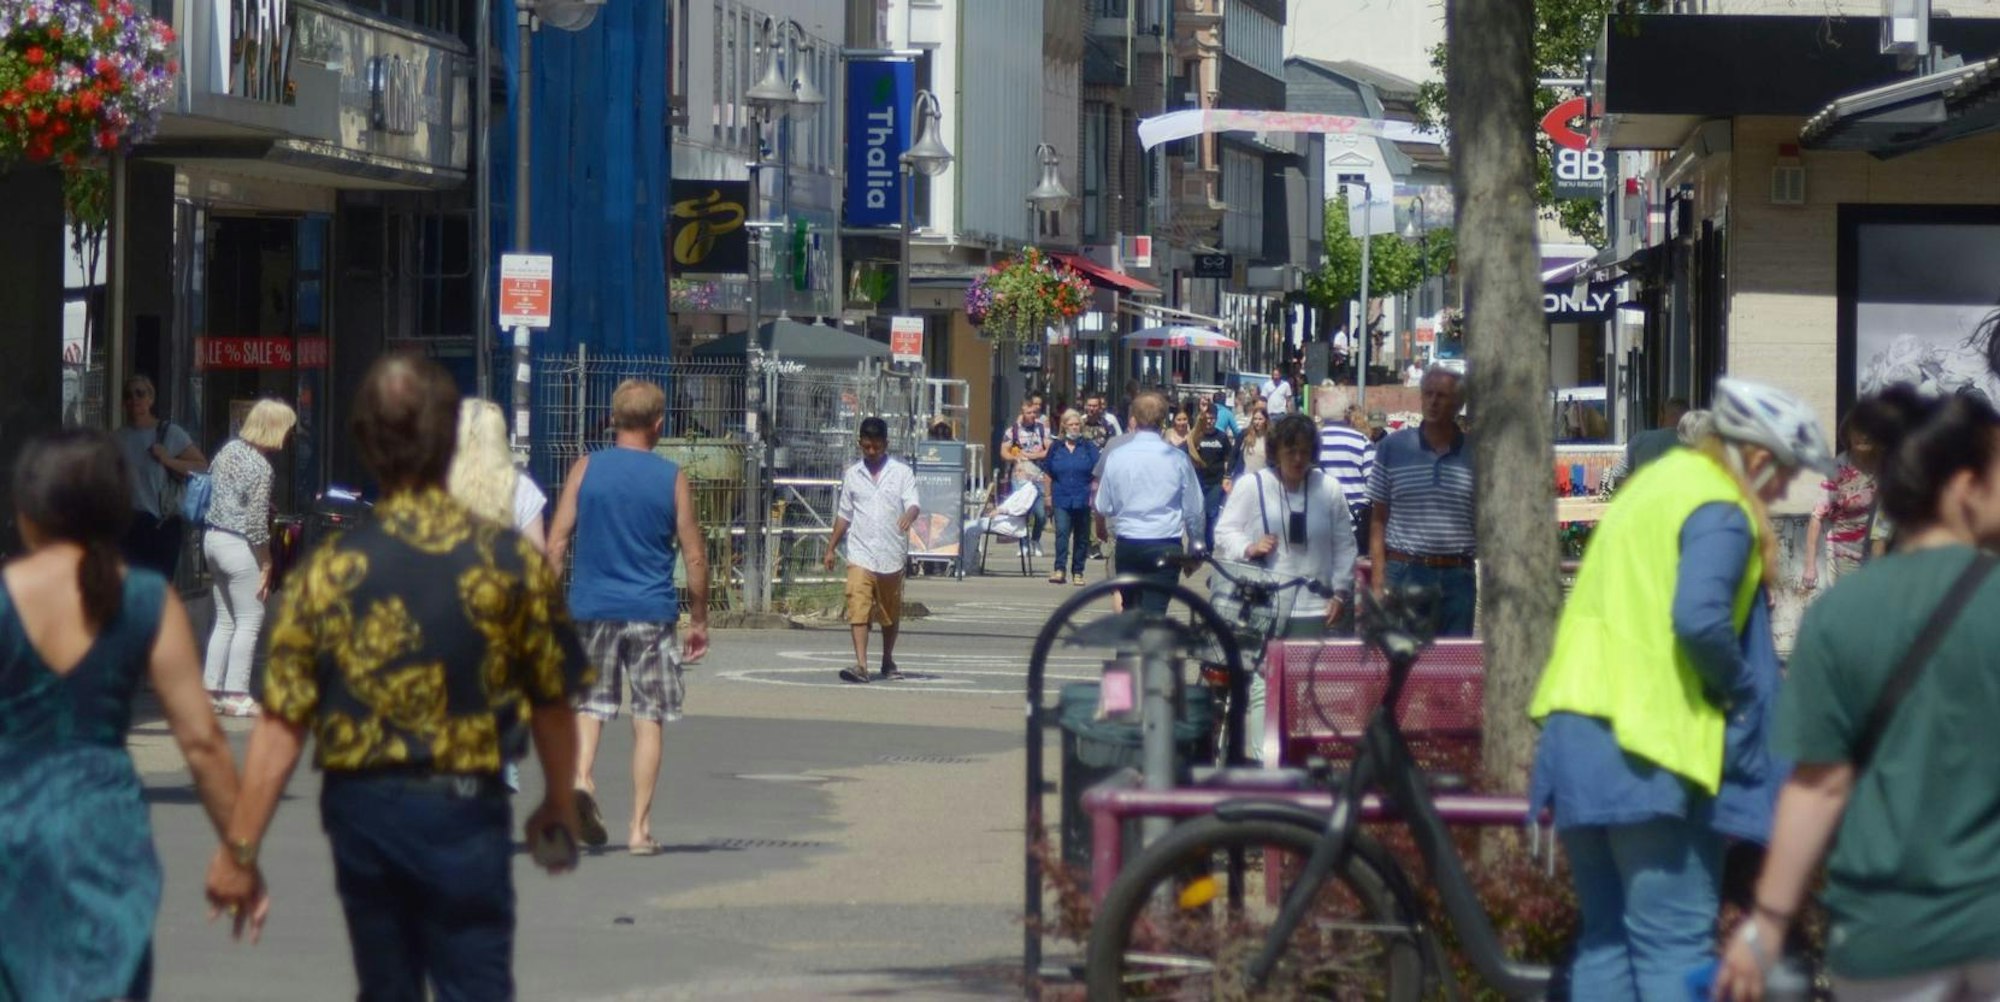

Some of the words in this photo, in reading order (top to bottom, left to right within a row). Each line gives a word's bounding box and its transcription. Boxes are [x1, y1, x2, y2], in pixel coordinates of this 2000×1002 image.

[867, 106, 893, 208] Thalia
[1543, 293, 1611, 313] ONLY
[243, 341, 274, 364] SALE
